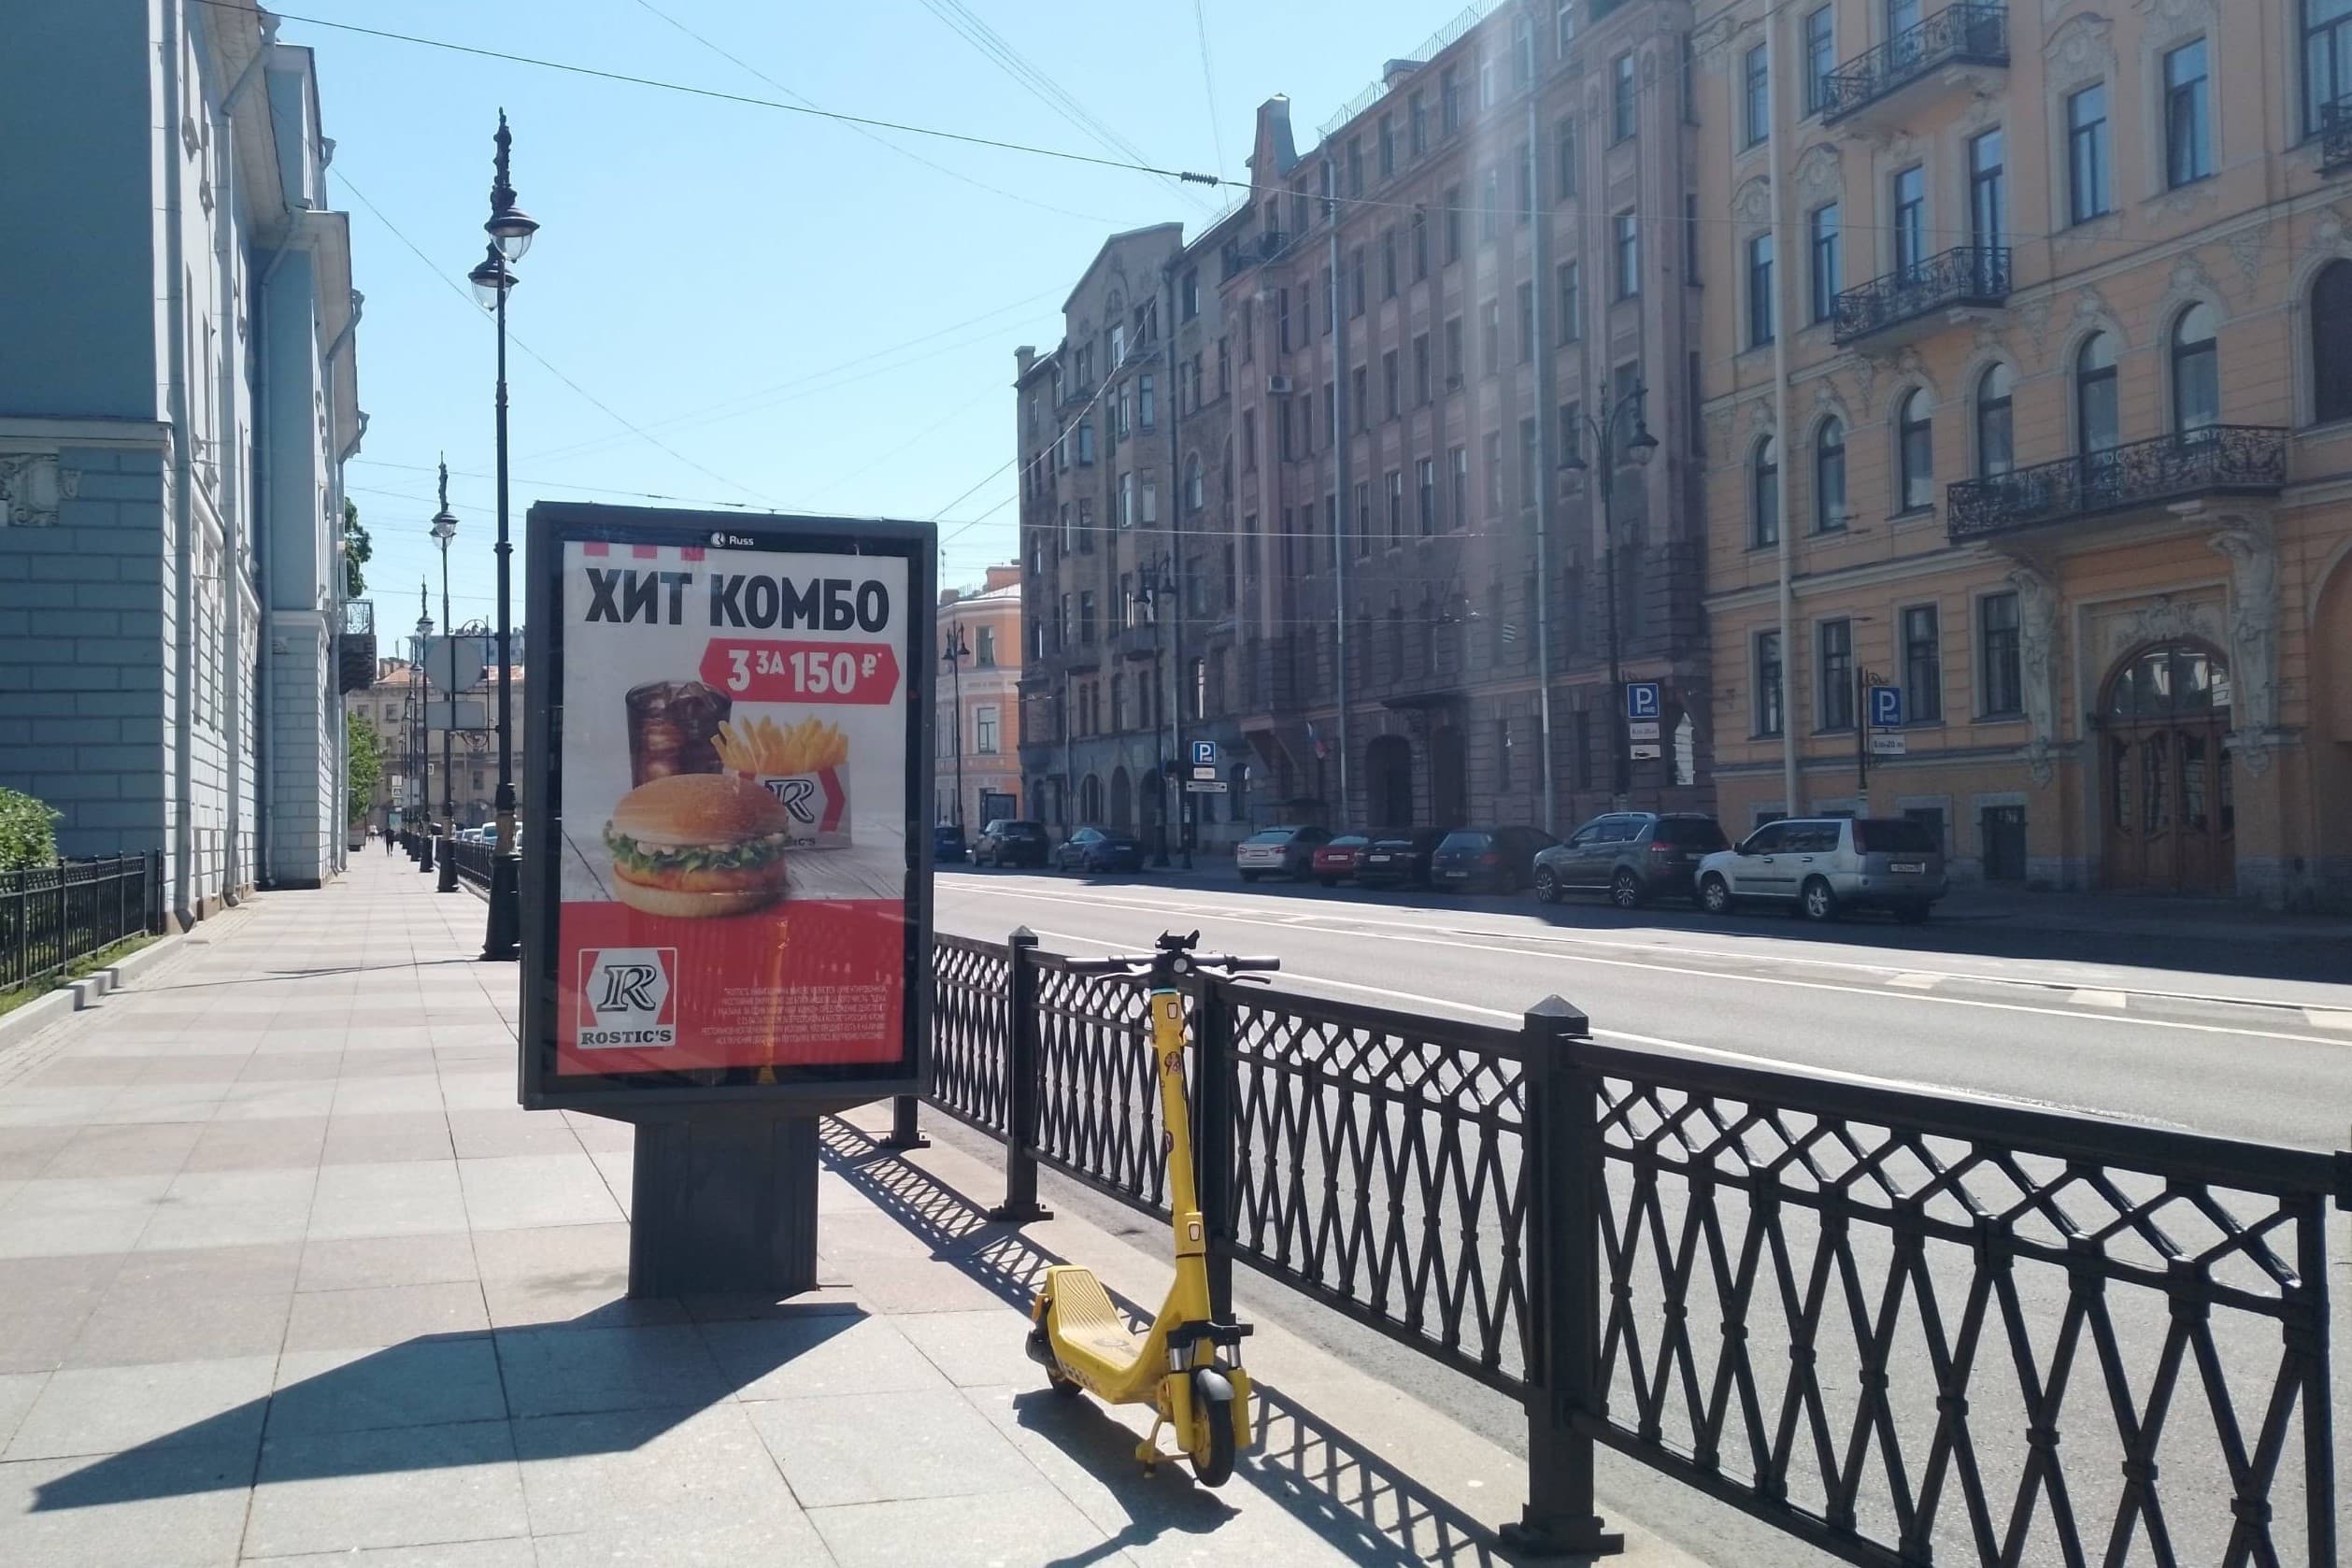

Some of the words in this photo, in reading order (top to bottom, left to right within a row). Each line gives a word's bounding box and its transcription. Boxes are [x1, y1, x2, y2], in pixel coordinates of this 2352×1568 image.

[729, 535, 754, 546] Russ
[585, 568, 692, 625] ХИТ
[709, 574, 890, 633] КОМБО
[727, 649, 750, 691] 3
[755, 650, 785, 675] ЗА
[581, 1030, 672, 1045] ROSTIC'S
